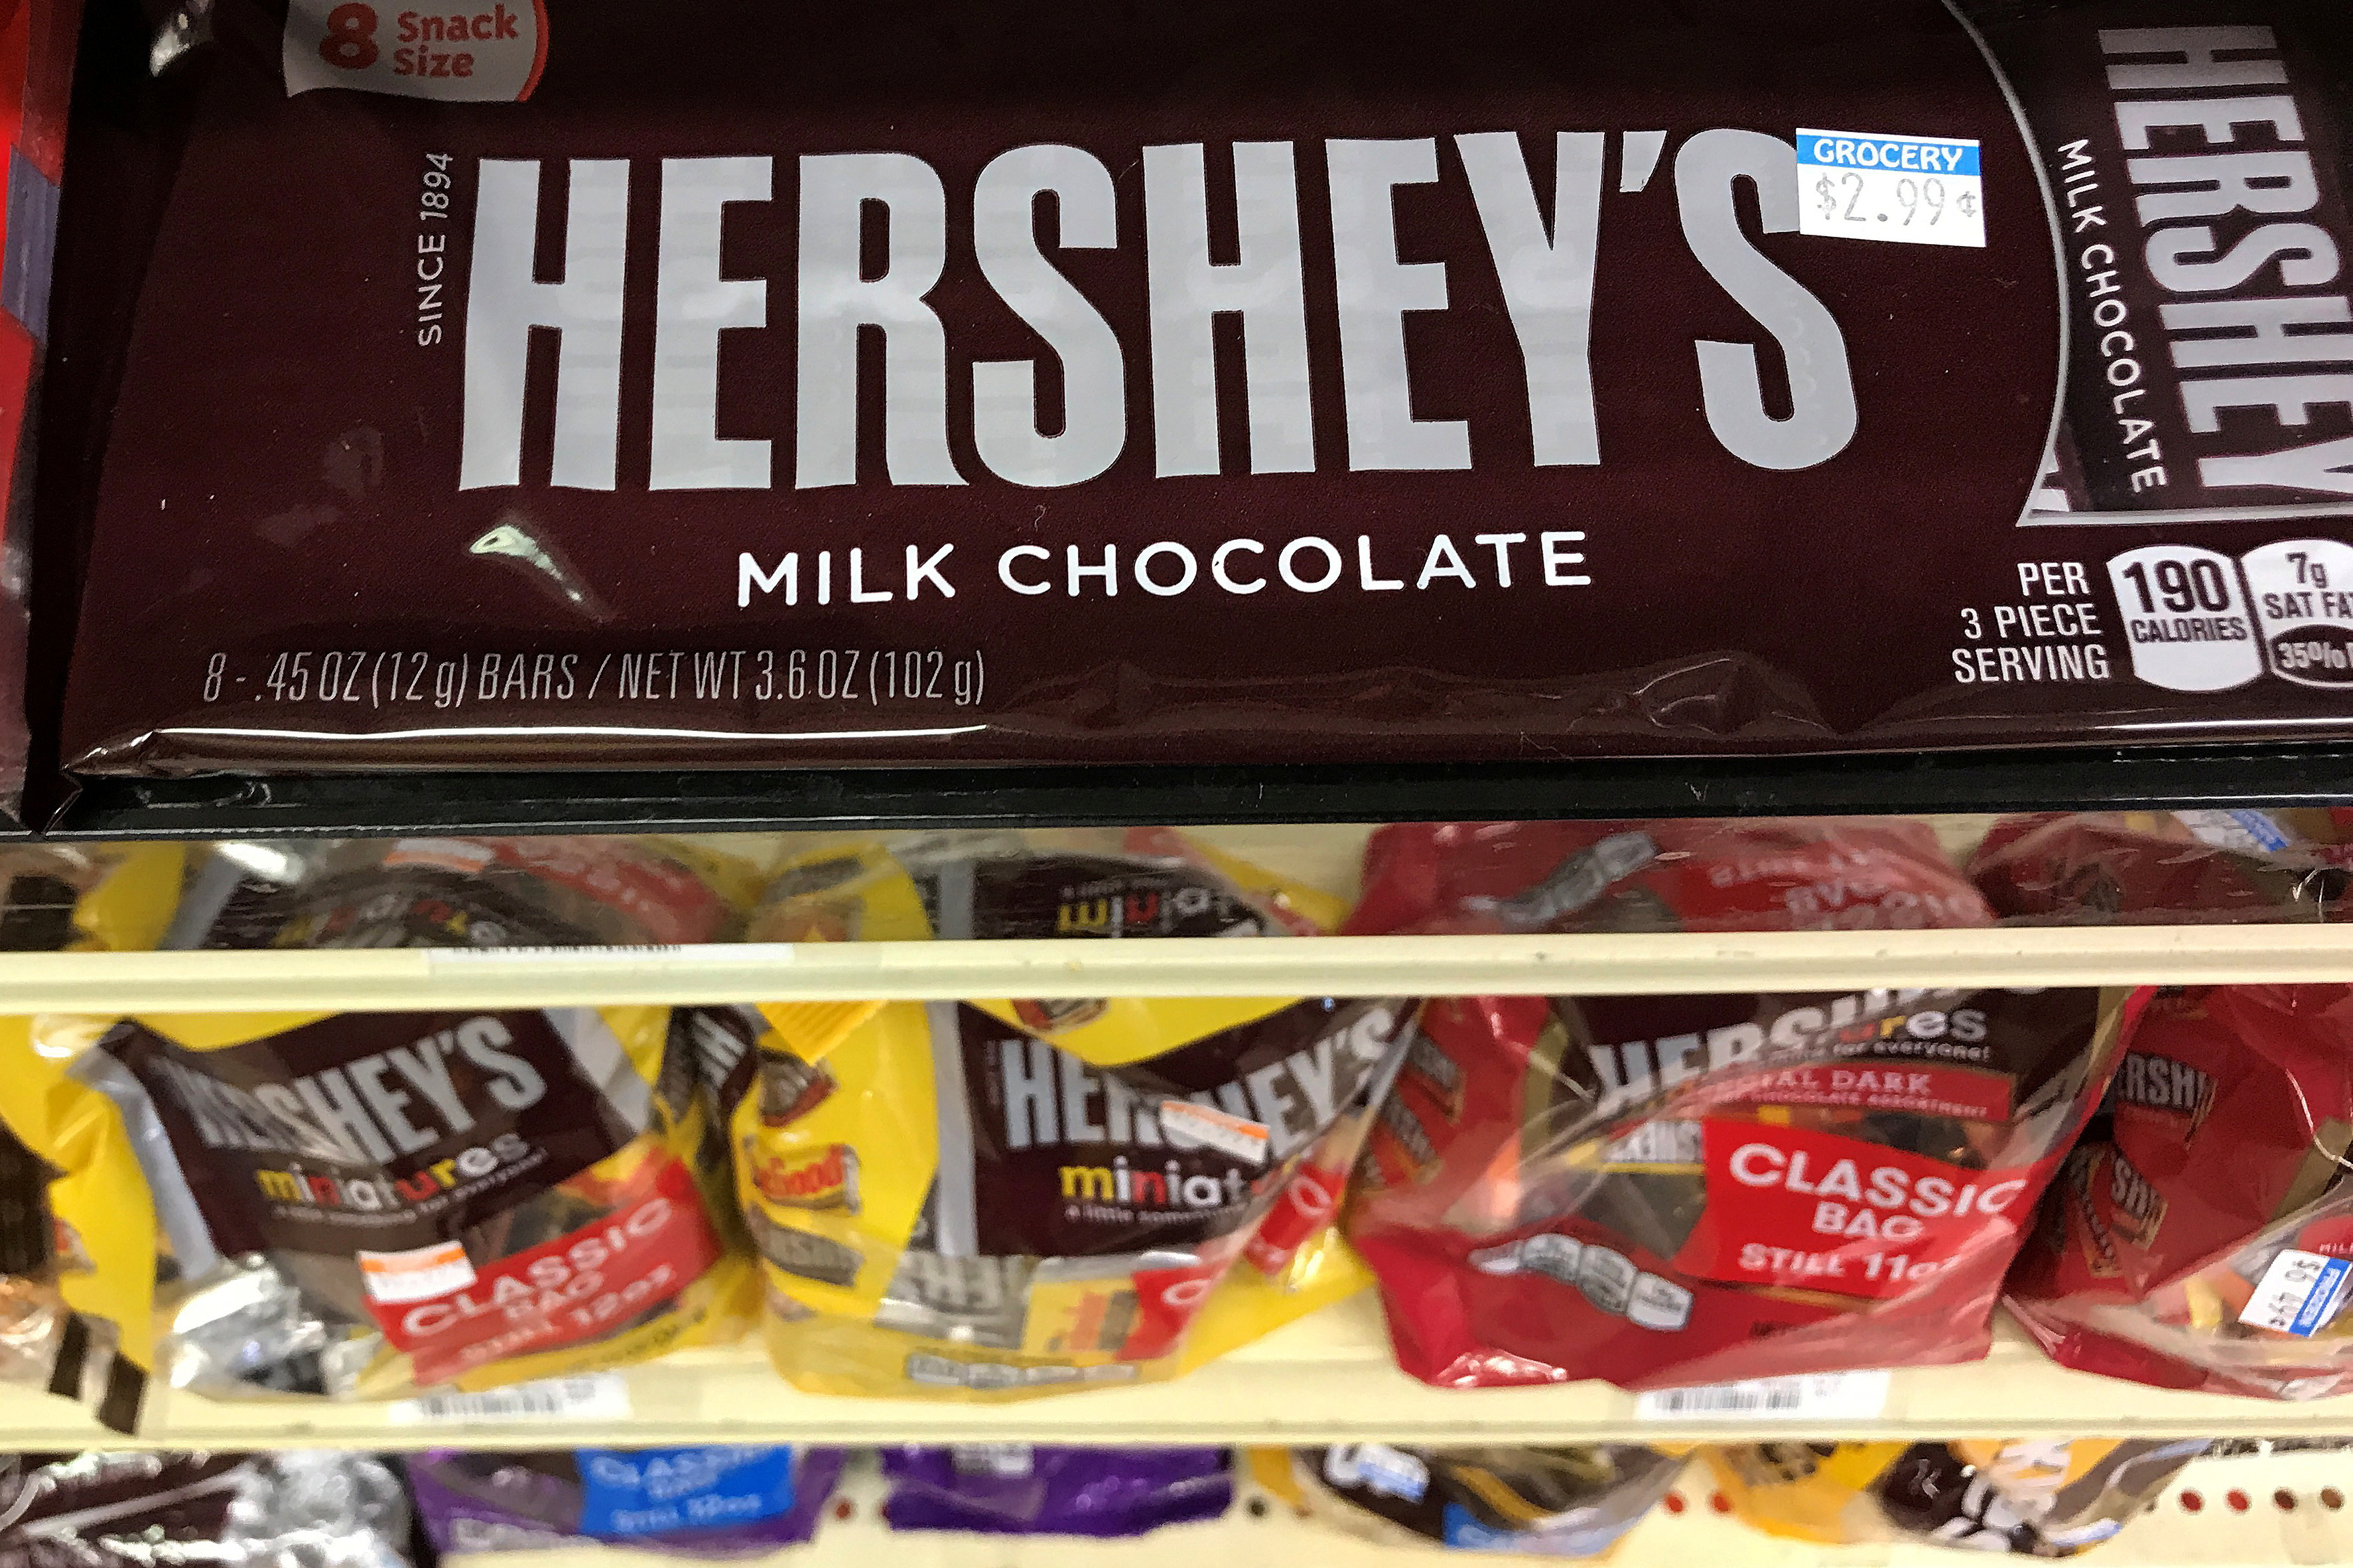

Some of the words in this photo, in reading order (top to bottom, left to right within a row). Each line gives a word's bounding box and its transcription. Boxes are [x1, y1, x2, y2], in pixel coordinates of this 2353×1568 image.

[320, 3, 378, 70] 8
[397, 4, 519, 41] Snack
[394, 46, 474, 78] Size
[1813, 138, 1963, 171] GROCERY
[421, 153, 453, 220] 1894
[2058, 139, 2107, 233] MILK
[2099, 26, 2353, 494] HERSHEY
[418, 233, 445, 346] SINCE
[459, 128, 1858, 491] HERSHEY'S
[2080, 243, 2169, 493] CHOCOLATE
[736, 543, 955, 608] MILK
[998, 530, 1592, 596] CHOCOLATE
[2017, 562, 2090, 596] PER
[2123, 558, 2230, 614] 190
[2285, 552, 2329, 589] 7g
[1960, 608, 1982, 639] 3
[1995, 603, 2102, 639] PIECE
[2130, 618, 2248, 644] CALORIES
[2263, 592, 2315, 620] SAT
[2321, 592, 2353, 618] FA
[203, 651, 227, 702] 8
[478, 653, 578, 700] BARS
[618, 651, 685, 700] NET
[694, 649, 747, 700] WT
[754, 649, 806, 700] 3.6
[818, 649, 860, 700] OZ
[1952, 643, 2110, 685] SERVING
[1831, 1070, 1932, 1094] DARK
[255, 1132, 531, 1211] miniatures
[1058, 1155, 1264, 1208] miniat
[1729, 1142, 2029, 1218] CLASSIC
[1811, 1201, 1925, 1244] BAG
[402, 1197, 674, 1337] CLASSIC
[1737, 1242, 1846, 1277] STILL
